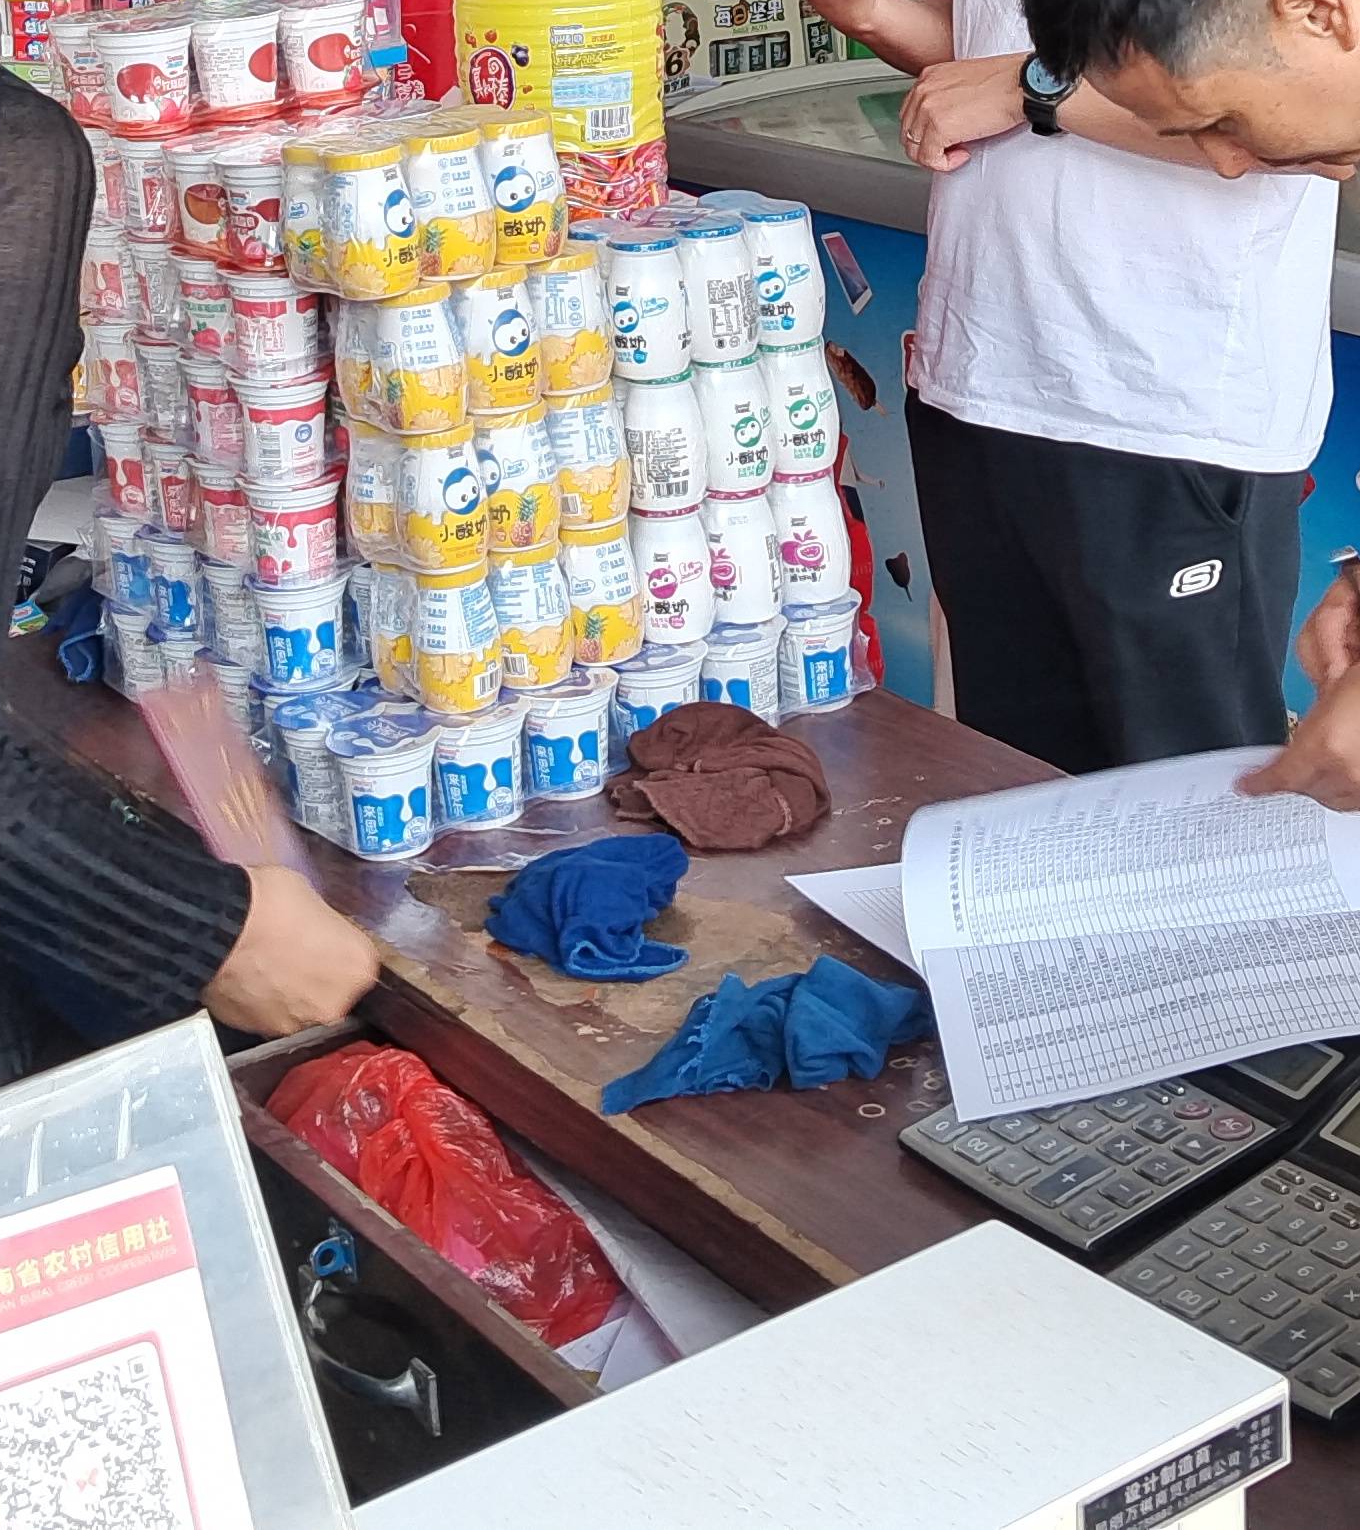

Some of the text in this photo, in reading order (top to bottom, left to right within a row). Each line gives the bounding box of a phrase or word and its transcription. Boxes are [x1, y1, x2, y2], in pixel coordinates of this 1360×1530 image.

[666, 51, 682, 76] 6
[498, 216, 546, 238] 酸奶
[759, 302, 795, 318] 酸奶
[614, 335, 647, 350] 酸奶
[489, 357, 538, 383] 小酸奶
[780, 429, 826, 448] 小酸奶
[726, 447, 769, 465] 小酸奶
[440, 515, 489, 544] 小酸奶
[643, 599, 690, 615] 小酸奶
[1112, 1098, 1130, 1111] 9
[935, 1120, 951, 1133] 0
[1005, 1120, 1023, 1132] 2
[1076, 1118, 1093, 1131] 6
[1219, 1119, 1244, 1135] AC
[967, 1137, 991, 1154] 00
[1041, 1139, 1061, 1153] 3
[1248, 1194, 1262, 1208] 7
[1207, 1220, 1227, 1233] 4
[1289, 1217, 1306, 1231] 8
[1175, 1242, 1190, 1258] 1
[1250, 1241, 1271, 1256] 5
[1331, 1239, 1348, 1254] 9
[1137, 1269, 1153, 1283] 0
[1214, 1264, 1234, 1280] 2
[1296, 1263, 1313, 1278] 6
[1176, 1287, 1205, 1307] 00
[1257, 1287, 1279, 1303] 3
